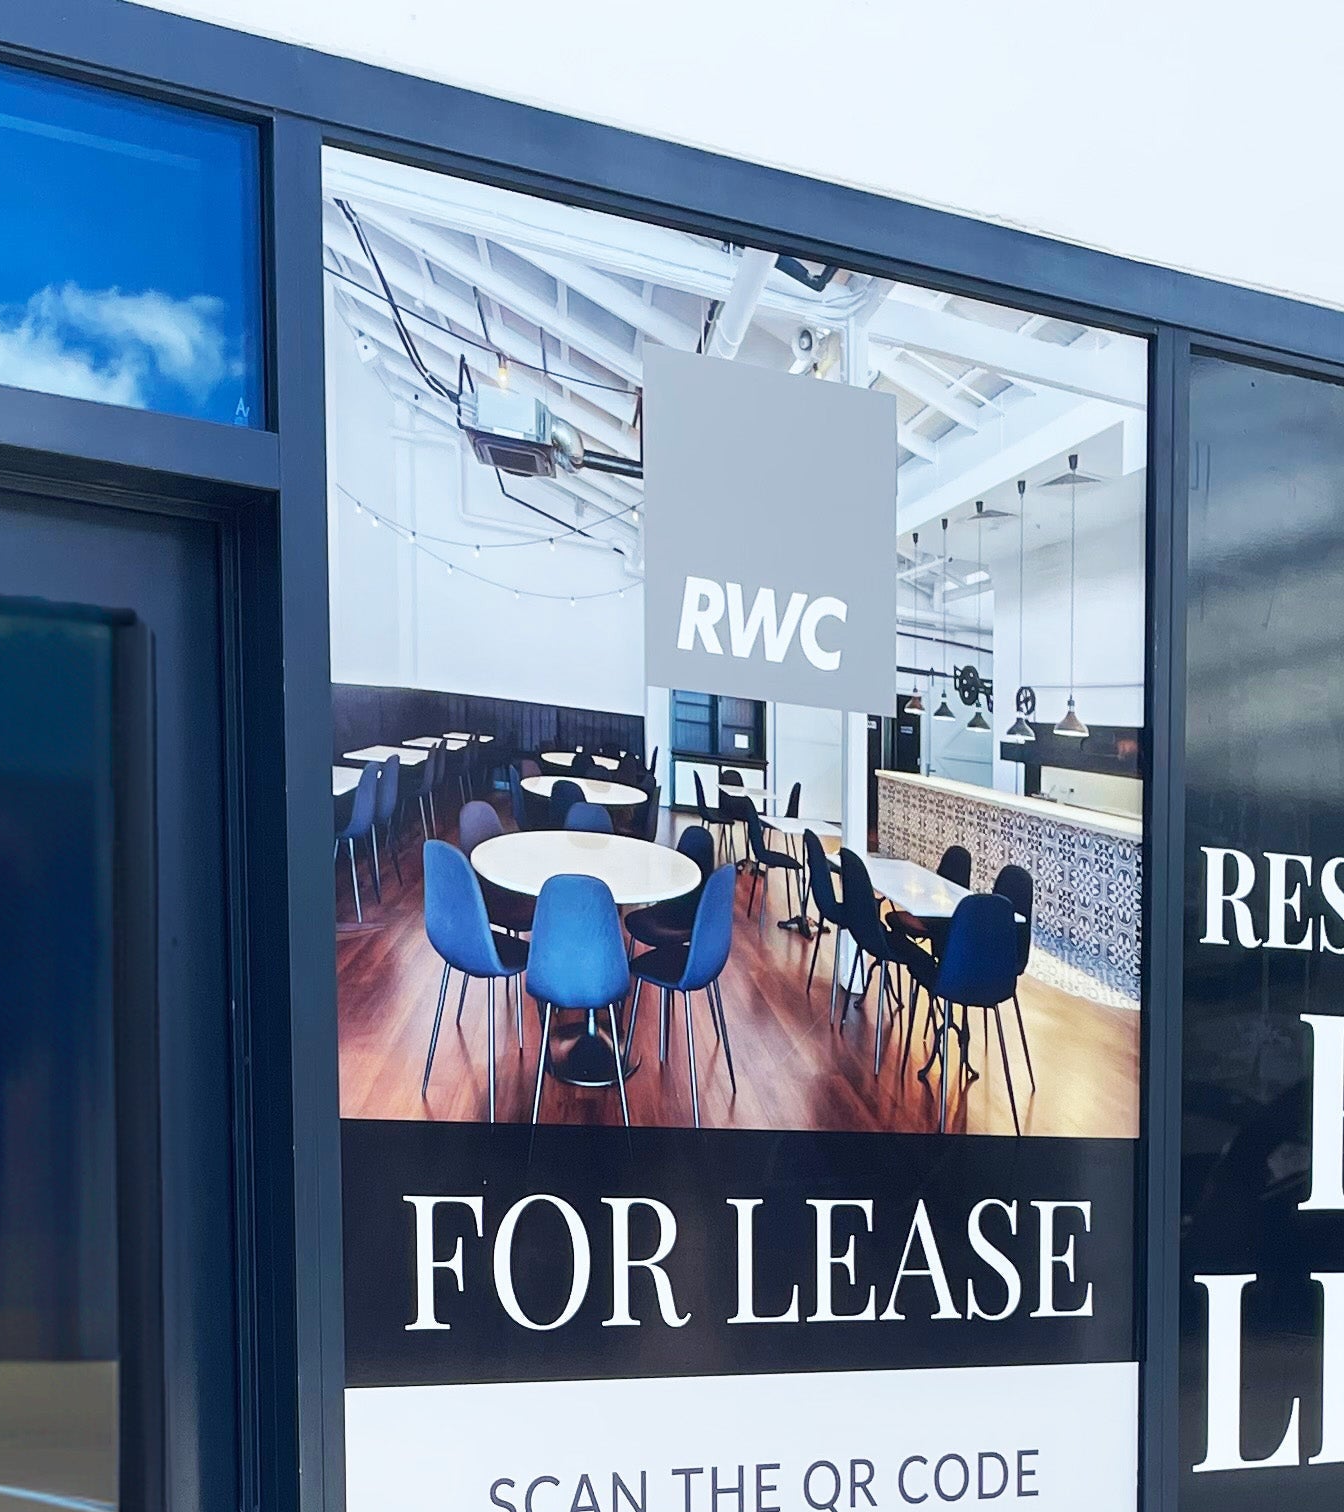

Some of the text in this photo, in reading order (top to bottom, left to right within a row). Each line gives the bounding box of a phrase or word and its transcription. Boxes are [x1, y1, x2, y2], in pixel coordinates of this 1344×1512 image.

[677, 575, 848, 671] RWC
[402, 1194, 1094, 1331] FOR LEASE
[897, 1449, 1040, 1505] CODE
